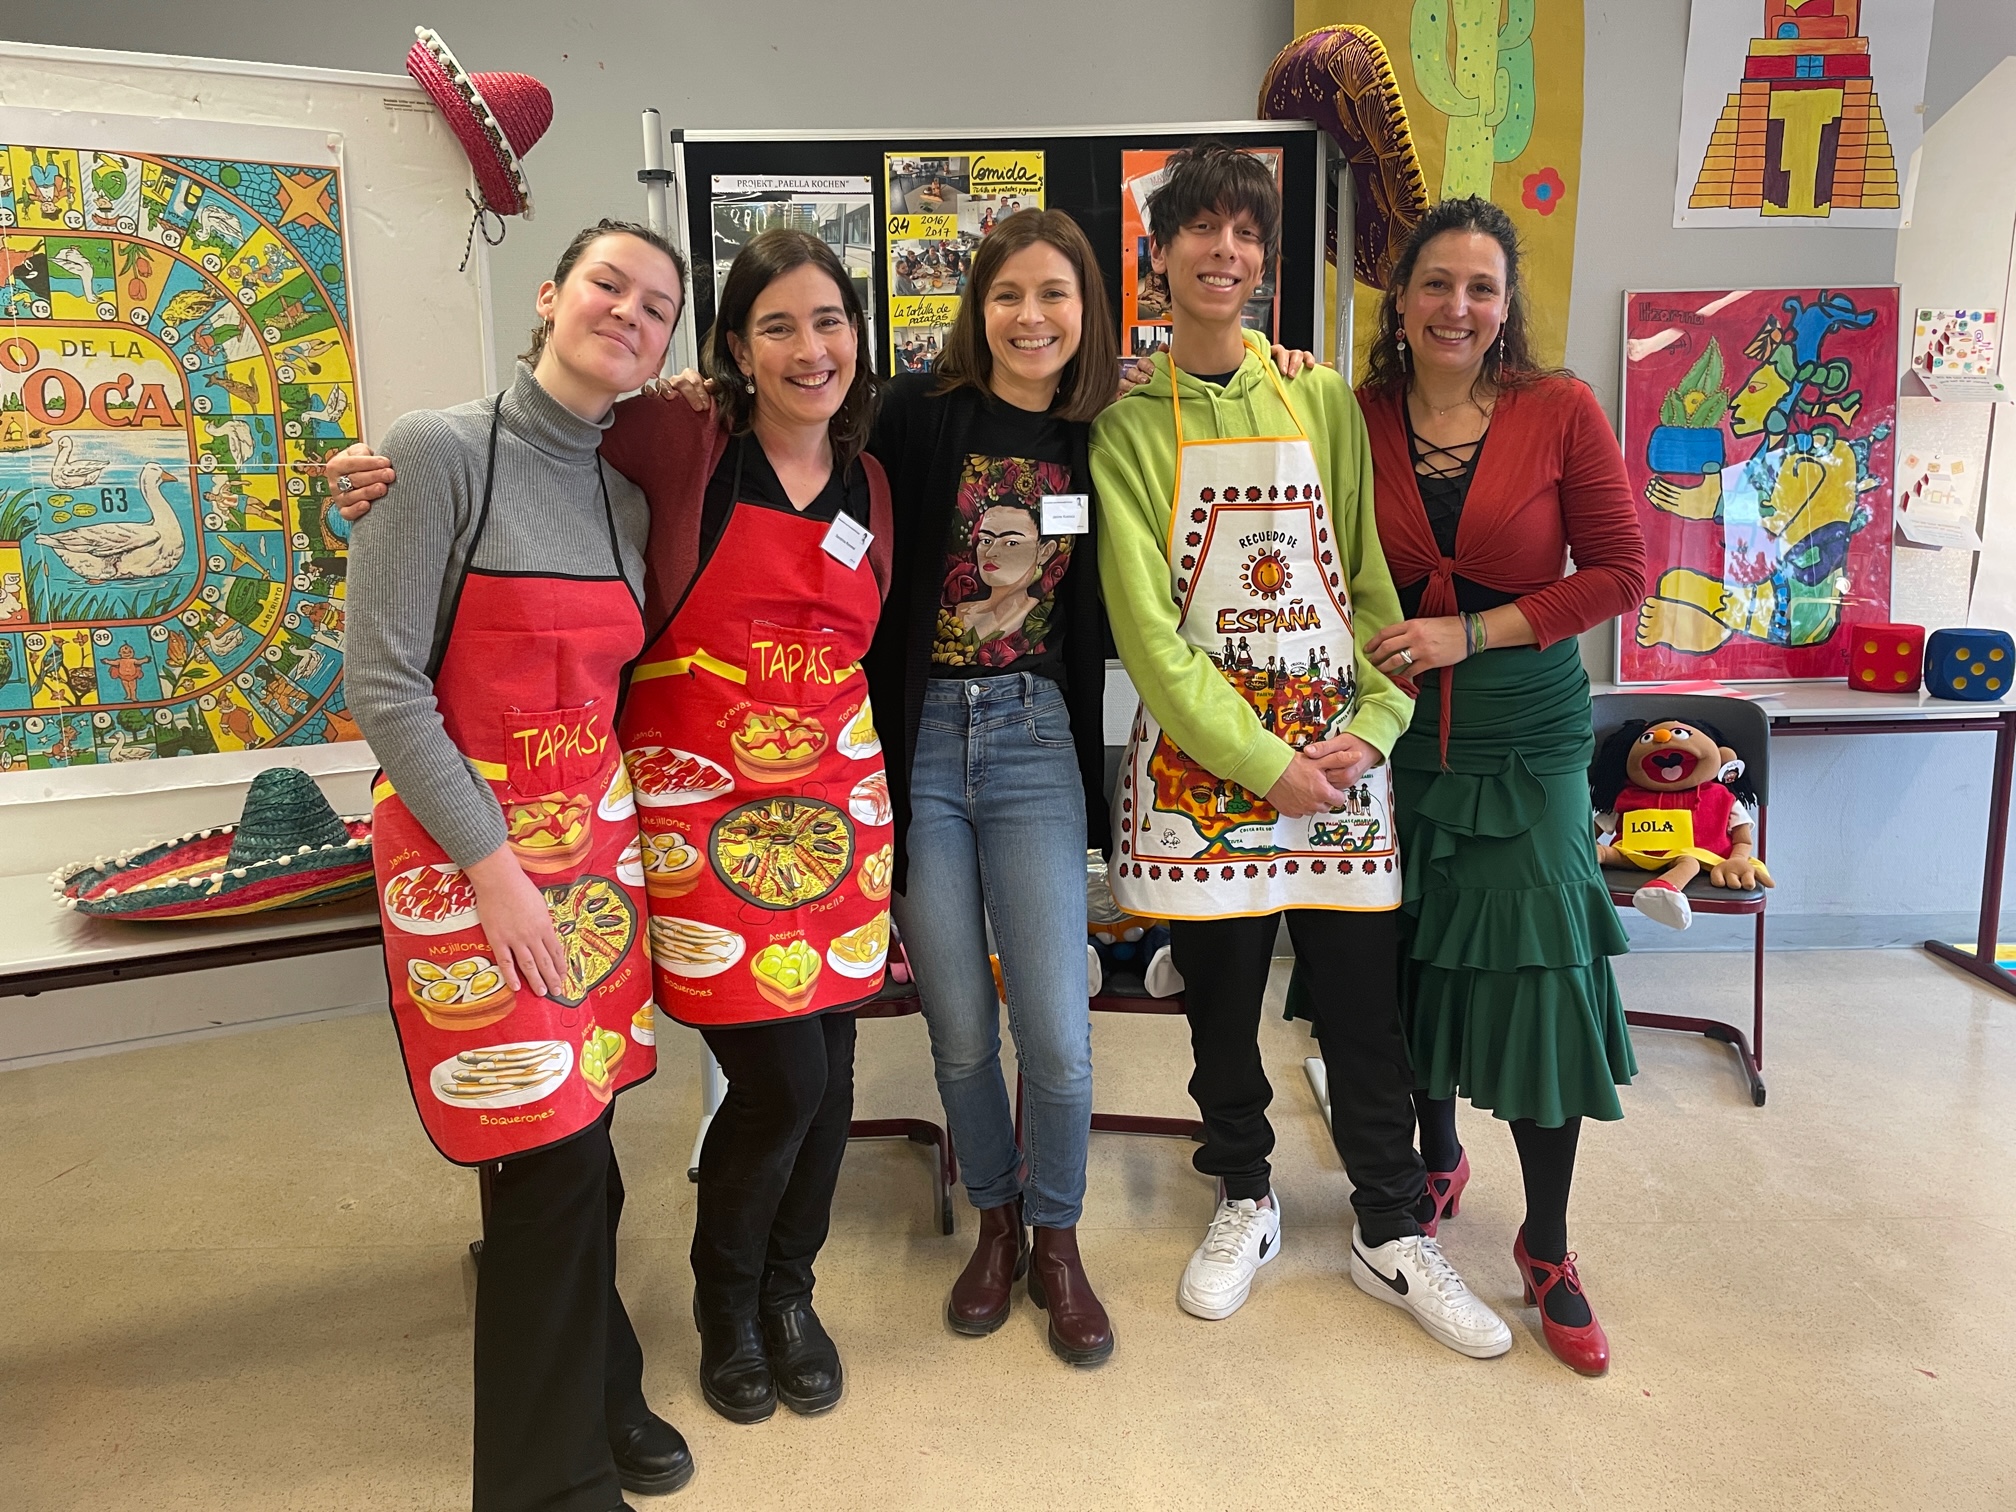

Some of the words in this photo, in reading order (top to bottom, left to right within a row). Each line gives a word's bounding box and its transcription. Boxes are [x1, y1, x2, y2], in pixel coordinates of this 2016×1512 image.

[972, 156, 1037, 181] Comida
[737, 180, 773, 188] PROJEKT
[68, 216, 81, 224] 21
[120, 222, 134, 230] 20
[888, 217, 910, 236] Q4
[925, 227, 950, 237] 2017
[166, 233, 179, 244] 19
[207, 258, 218, 269] 18
[242, 292, 252, 302] 17
[34, 305, 49, 314] 51
[937, 303, 951, 313] de
[132, 312, 148, 322] 49
[908, 314, 948, 326] patatas
[163, 330, 176, 341] 48
[266, 328, 276, 340] 16
[60, 340, 97, 358] DE
[110, 340, 144, 358] LA
[186, 357, 196, 368] 47
[285, 368, 292, 380] 15
[21, 368, 183, 427] OCA
[199, 399, 206, 410] 46
[290, 423, 297, 435] 14
[293, 481, 300, 492] 13
[101, 487, 128, 513] 63
[210, 515, 217, 527] 44
[298, 535, 304, 547] 12
[1287, 535, 1298, 548] DE
[214, 558, 220, 569] 43
[298, 576, 305, 588] 11
[206, 588, 216, 599] 42
[260, 587, 283, 628] LABERINTO
[186, 612, 197, 623] 41
[287, 614, 296, 626] 10
[1216, 598, 1321, 634] ESPAÑA
[153, 629, 166, 638] 40
[752, 641, 832, 684] TAPAS
[717, 701, 752, 729] Bravas
[632, 728, 662, 742] Jamón
[513, 714, 598, 770] TAPAS
[642, 816, 692, 832] Mejillones
[1631, 821, 1675, 833] LOLA
[389, 848, 420, 870] Jamón
[810, 895, 845, 914] Paella
[428, 943, 492, 957] Mejillones
[598, 968, 632, 998] Paella
[664, 974, 713, 997] Boquerones
[480, 1108, 555, 1125] Boquerones
